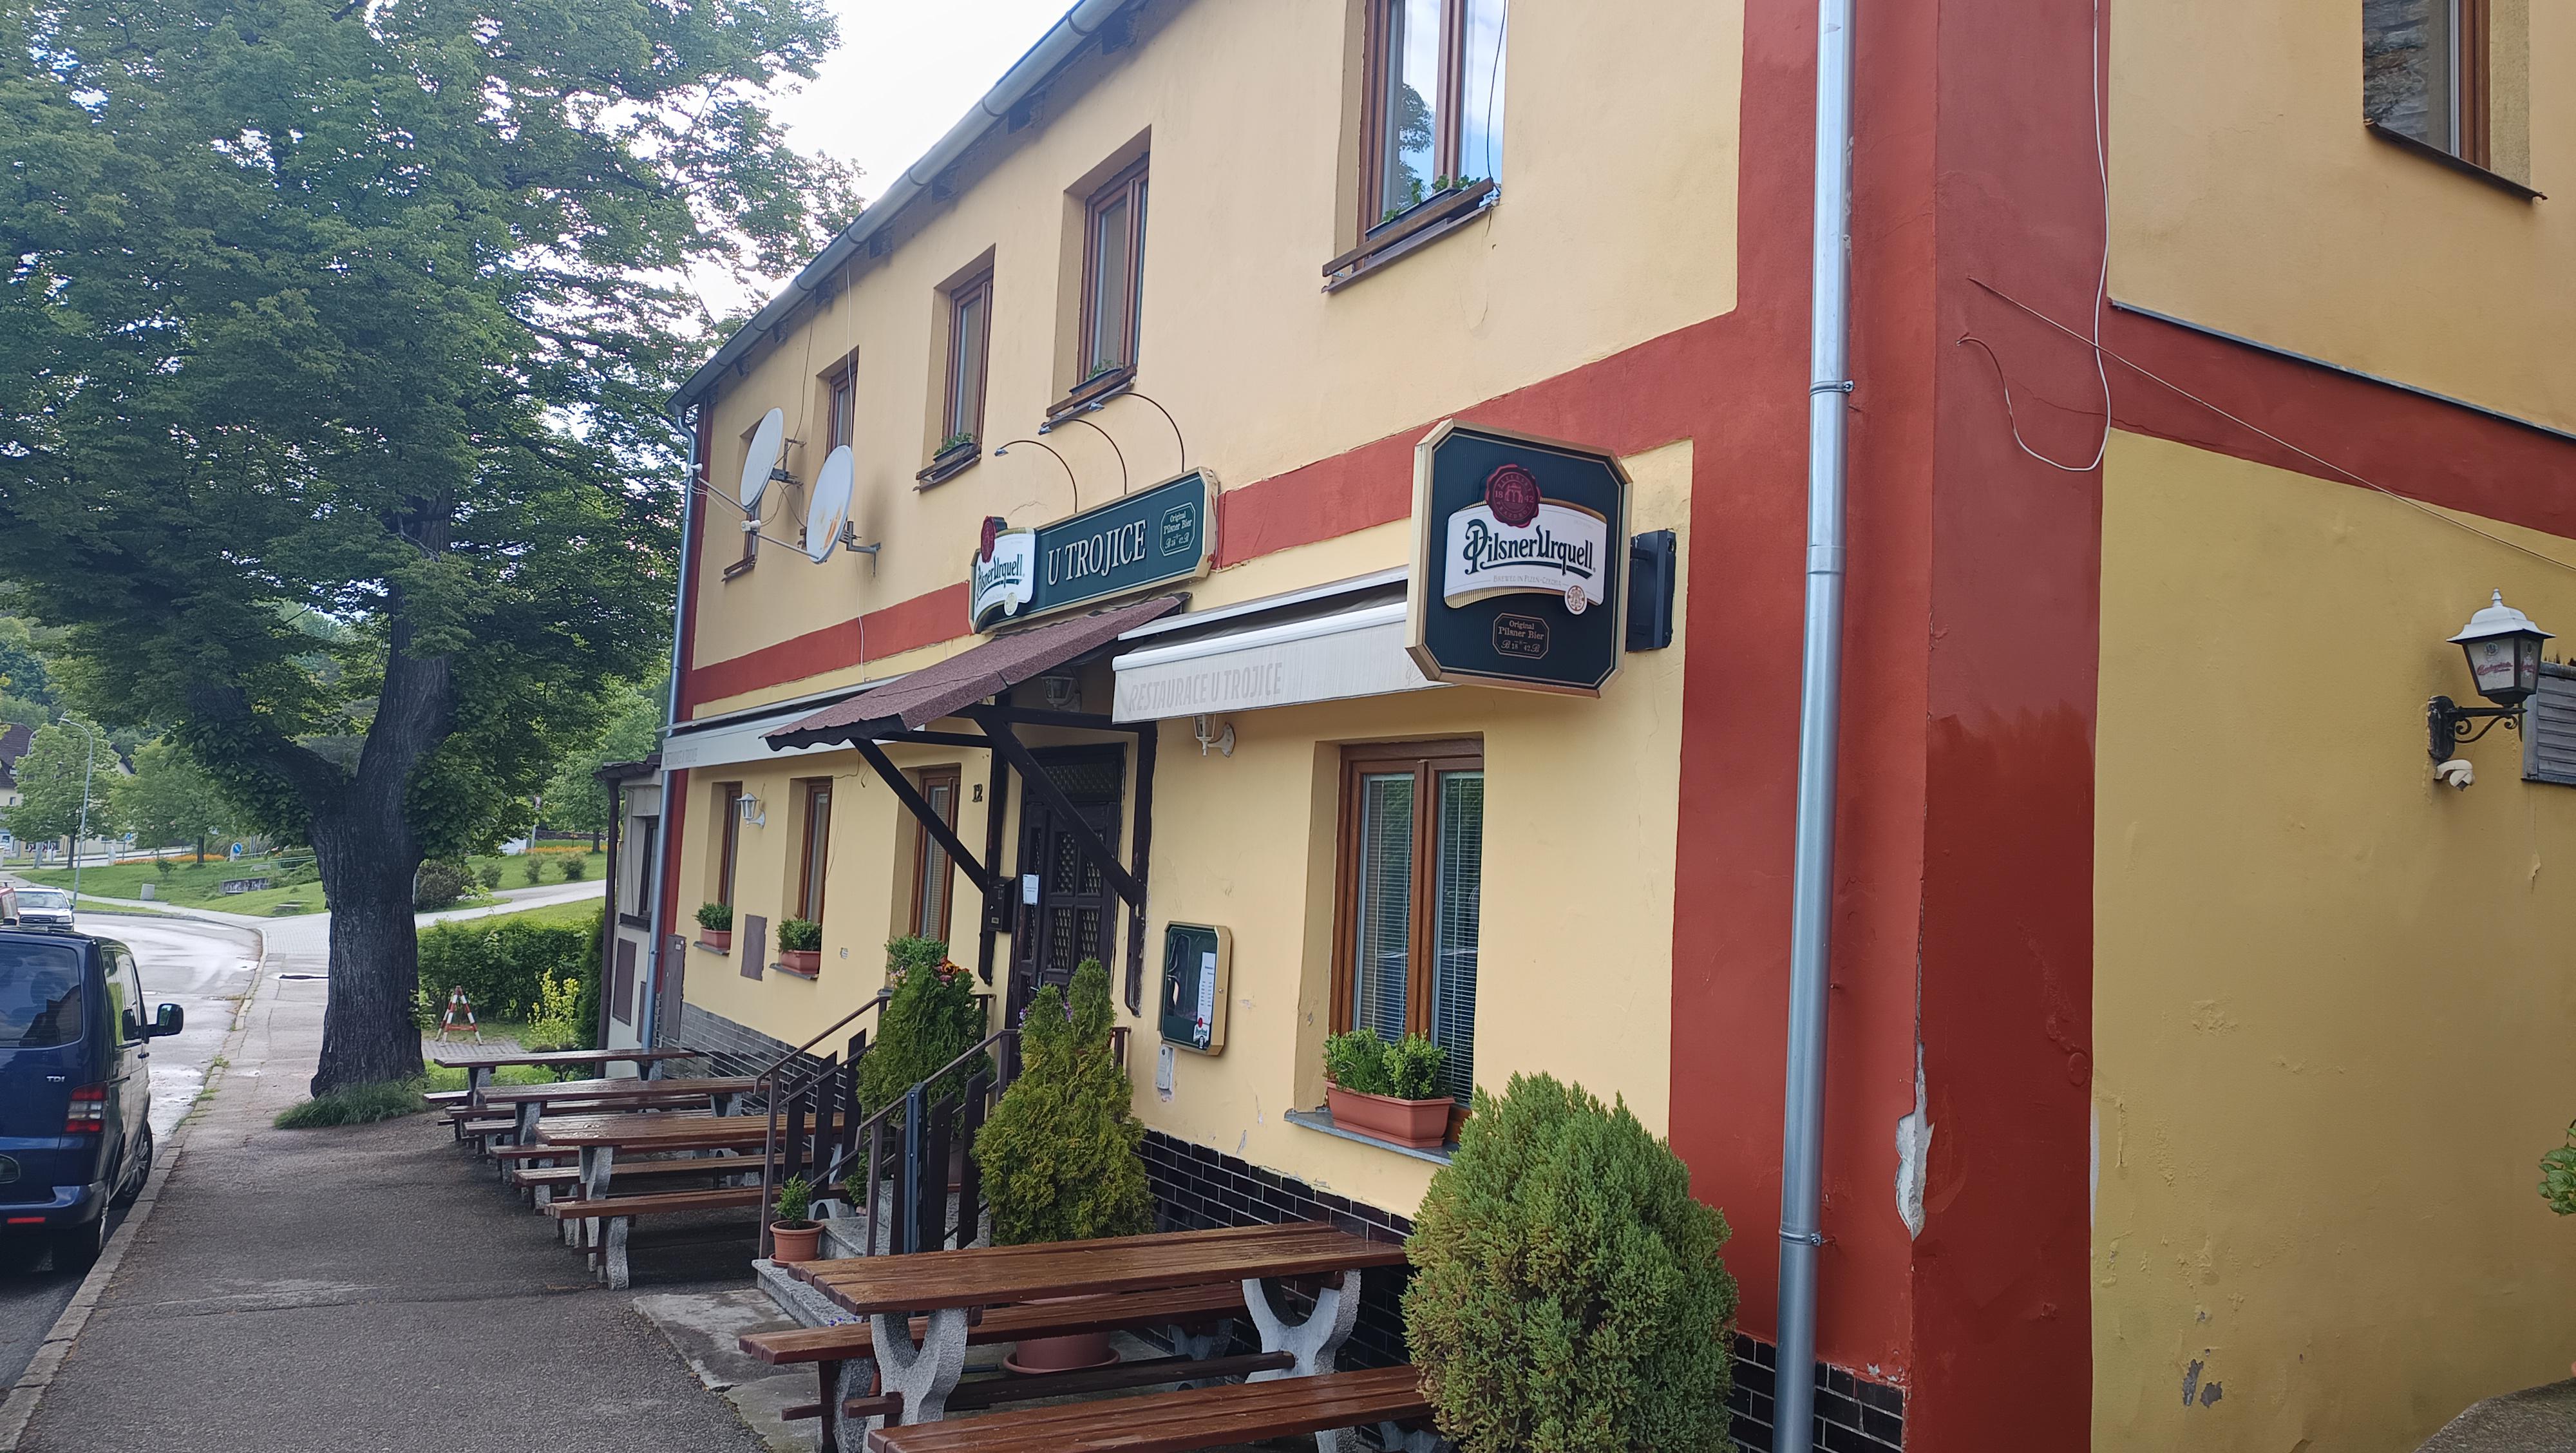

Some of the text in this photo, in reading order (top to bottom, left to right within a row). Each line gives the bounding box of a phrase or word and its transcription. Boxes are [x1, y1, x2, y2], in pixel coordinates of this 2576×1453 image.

[1495, 490, 1534, 503] 18 42
[1182, 518, 1192, 529] Bier
[1048, 519, 1146, 585] U TROJICE
[1463, 518, 1593, 576] Pilsner Urquell
[994, 553, 1023, 589] Urquell
[1498, 626, 1544, 640] Pilsner Bier
[1509, 620, 1535, 629] Original
[1129, 662, 1283, 712] RESTAURACE U TROJICE
[972, 783, 983, 802] 12
